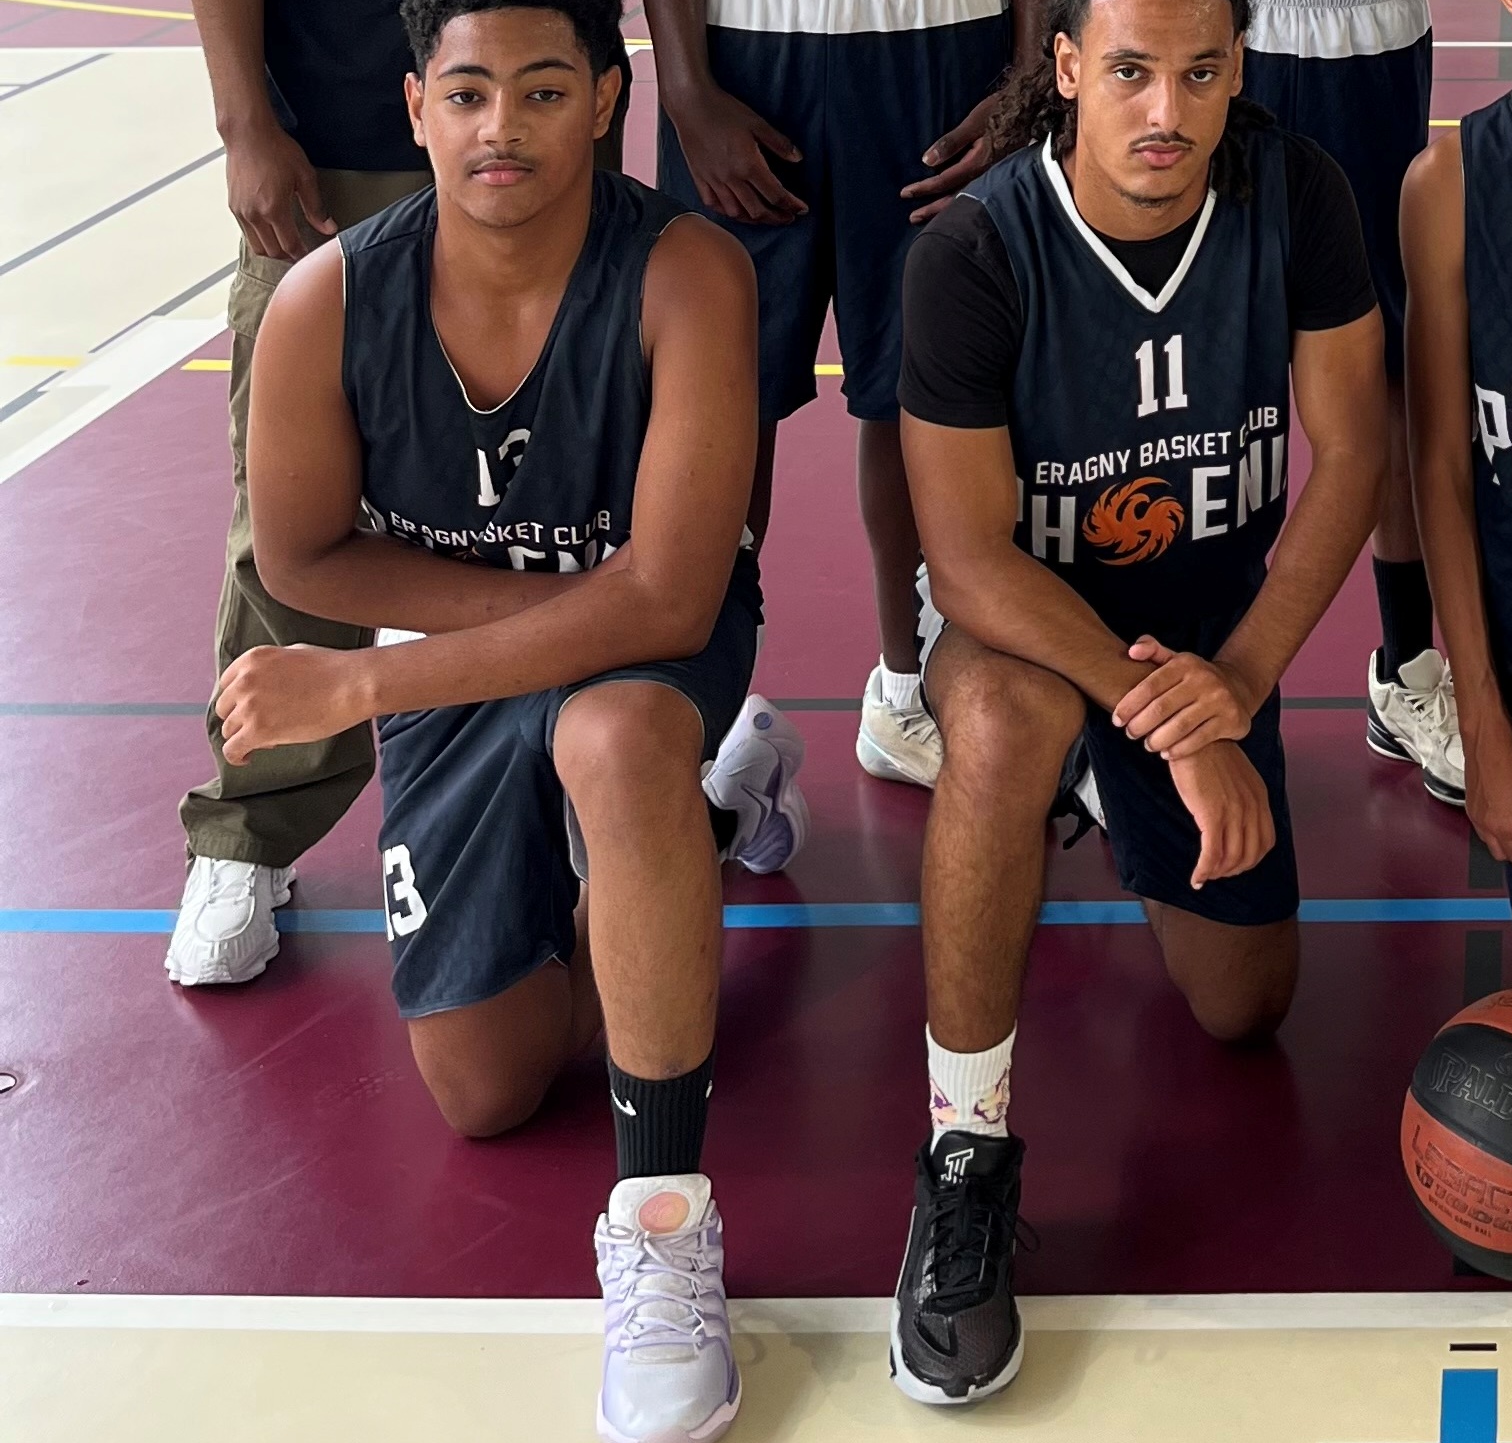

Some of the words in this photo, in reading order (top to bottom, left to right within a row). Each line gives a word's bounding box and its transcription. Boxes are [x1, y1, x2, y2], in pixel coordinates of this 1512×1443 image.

[1135, 334, 1188, 418] 11
[1036, 449, 1130, 485] ERAGNY
[1140, 431, 1232, 468] BASKET
[1240, 406, 1278, 448] CUB
[391, 511, 485, 548] ERAGNY
[484, 521, 543, 545] SKET
